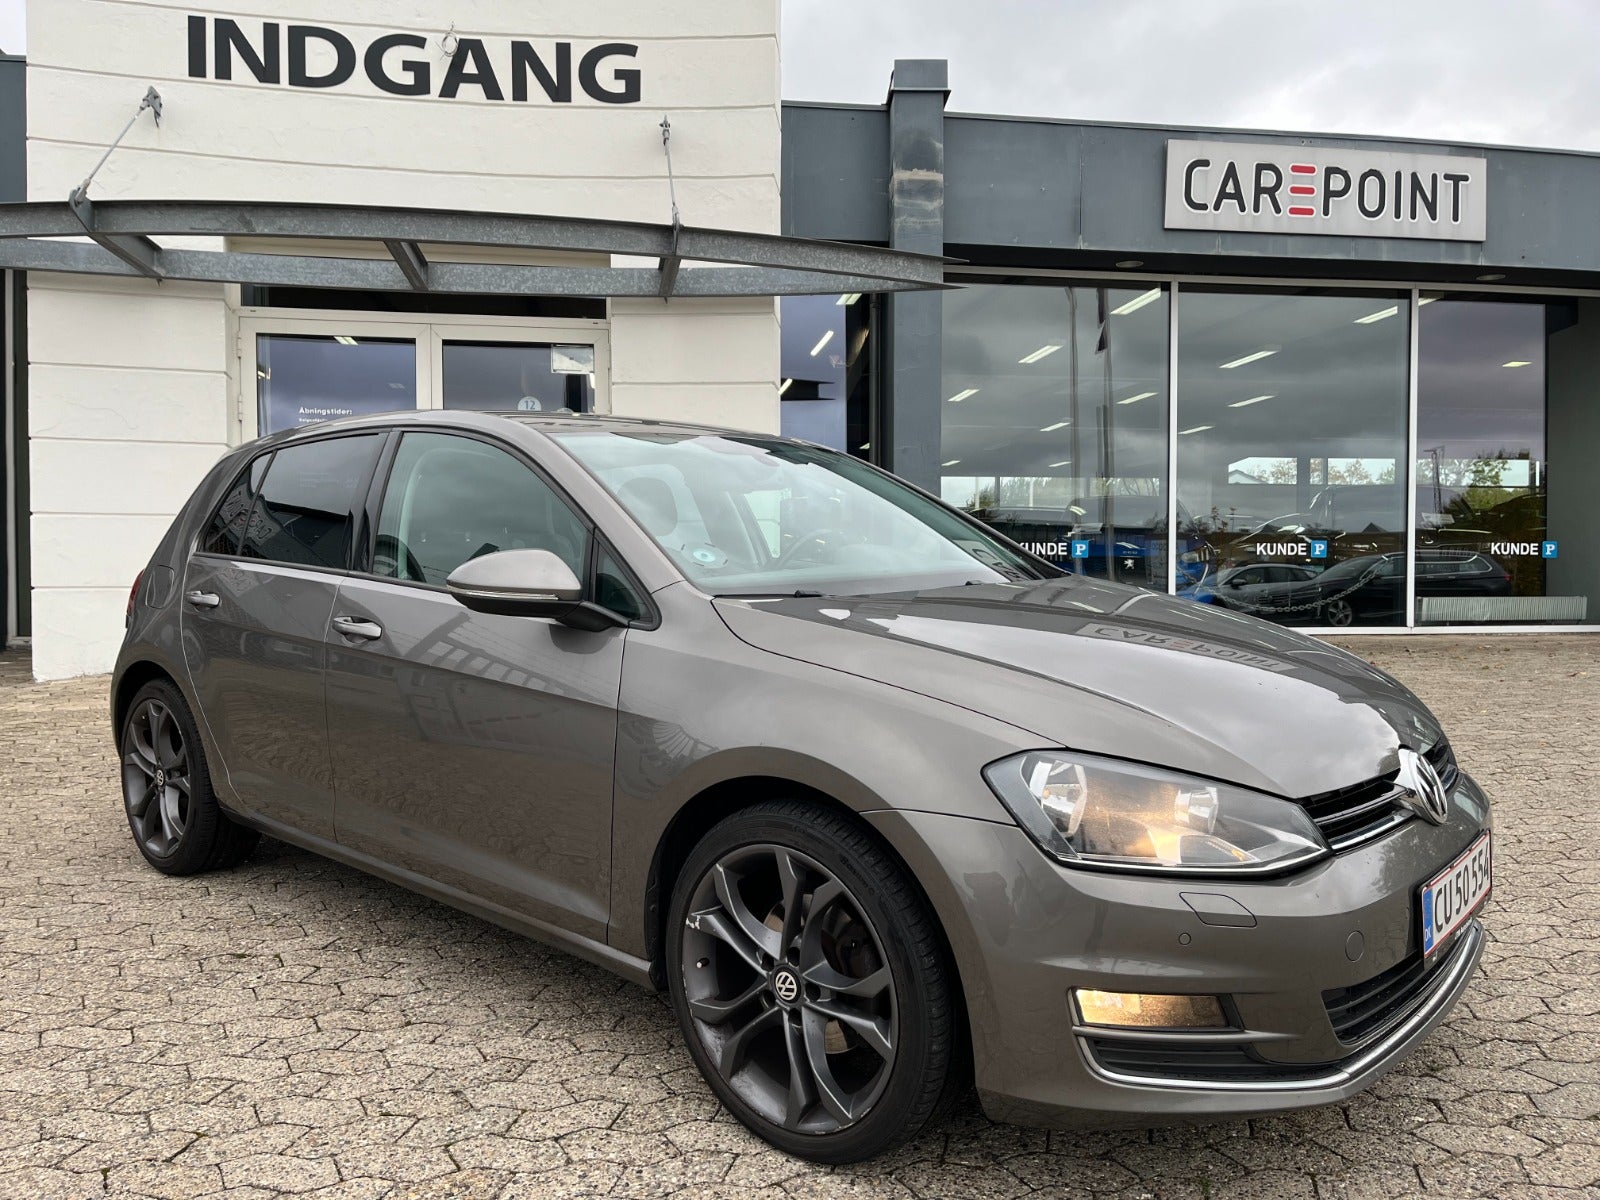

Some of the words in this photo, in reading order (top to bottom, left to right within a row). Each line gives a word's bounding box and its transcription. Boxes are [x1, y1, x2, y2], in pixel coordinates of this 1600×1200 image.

[187, 15, 642, 104] INDGANG
[1256, 542, 1307, 556] KUNDE
[1313, 542, 1326, 556] P
[1490, 542, 1539, 556] KUNDE
[1544, 543, 1556, 556] P
[1435, 879, 1453, 933] CU
[1455, 864, 1470, 915] 50
[1471, 842, 1489, 898] 554
